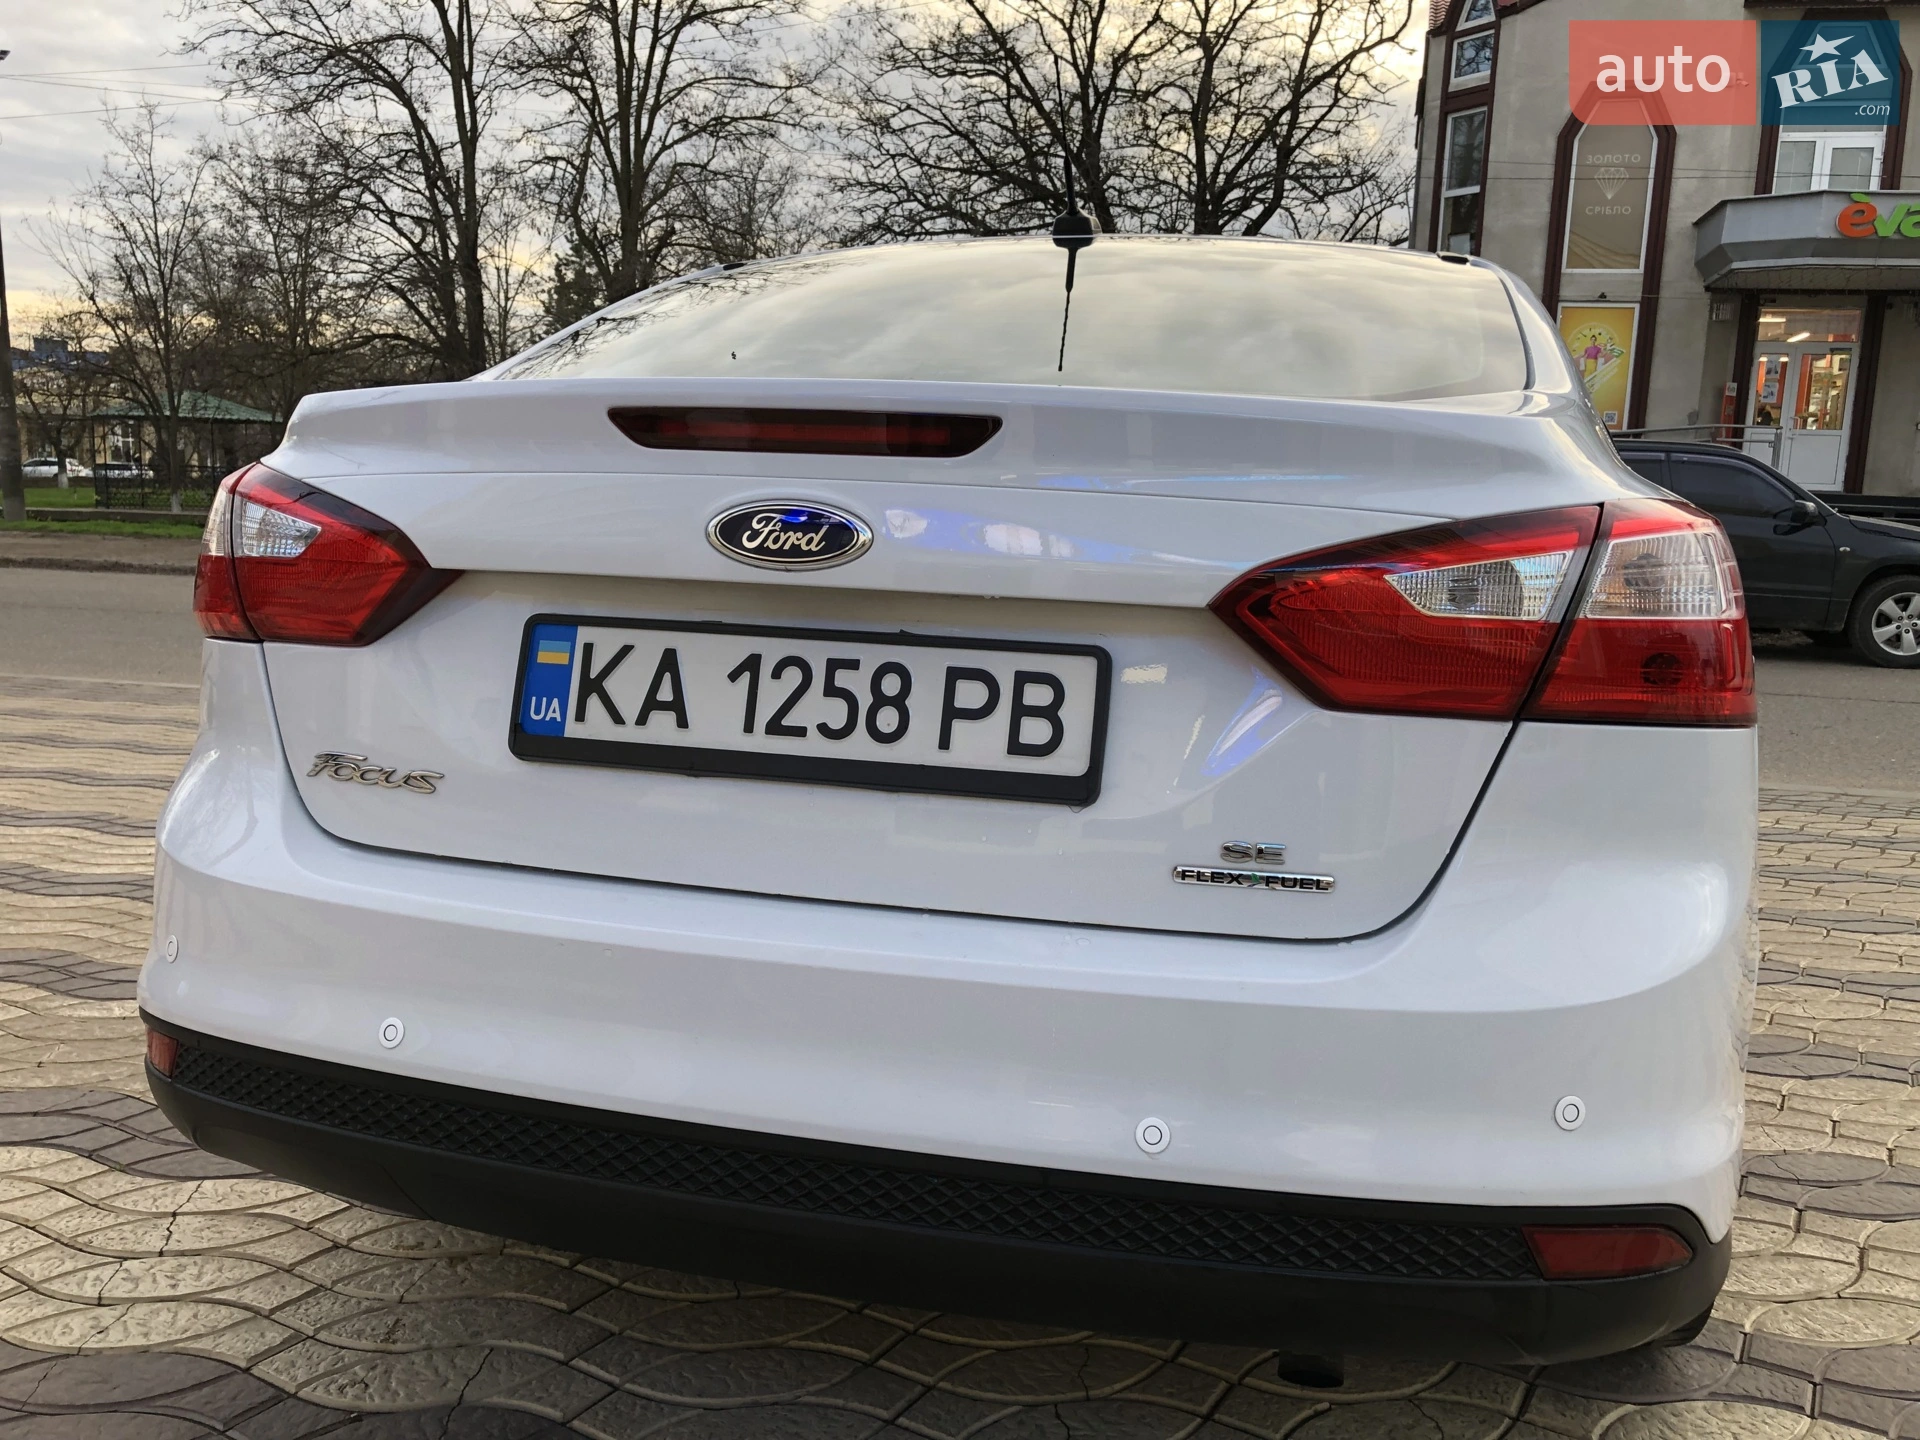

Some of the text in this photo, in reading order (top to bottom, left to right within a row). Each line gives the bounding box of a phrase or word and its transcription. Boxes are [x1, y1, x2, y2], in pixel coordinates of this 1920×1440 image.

[1585, 154, 1641, 164] ЗОЛОТО
[1585, 205, 1632, 215] СРІБЛО
[741, 513, 830, 551] Ford
[529, 696, 562, 722] UA
[574, 642, 1066, 758] KA 1258 PB
[1220, 840, 1287, 865] SE
[1180, 869, 1330, 891] FLEX FUEL
